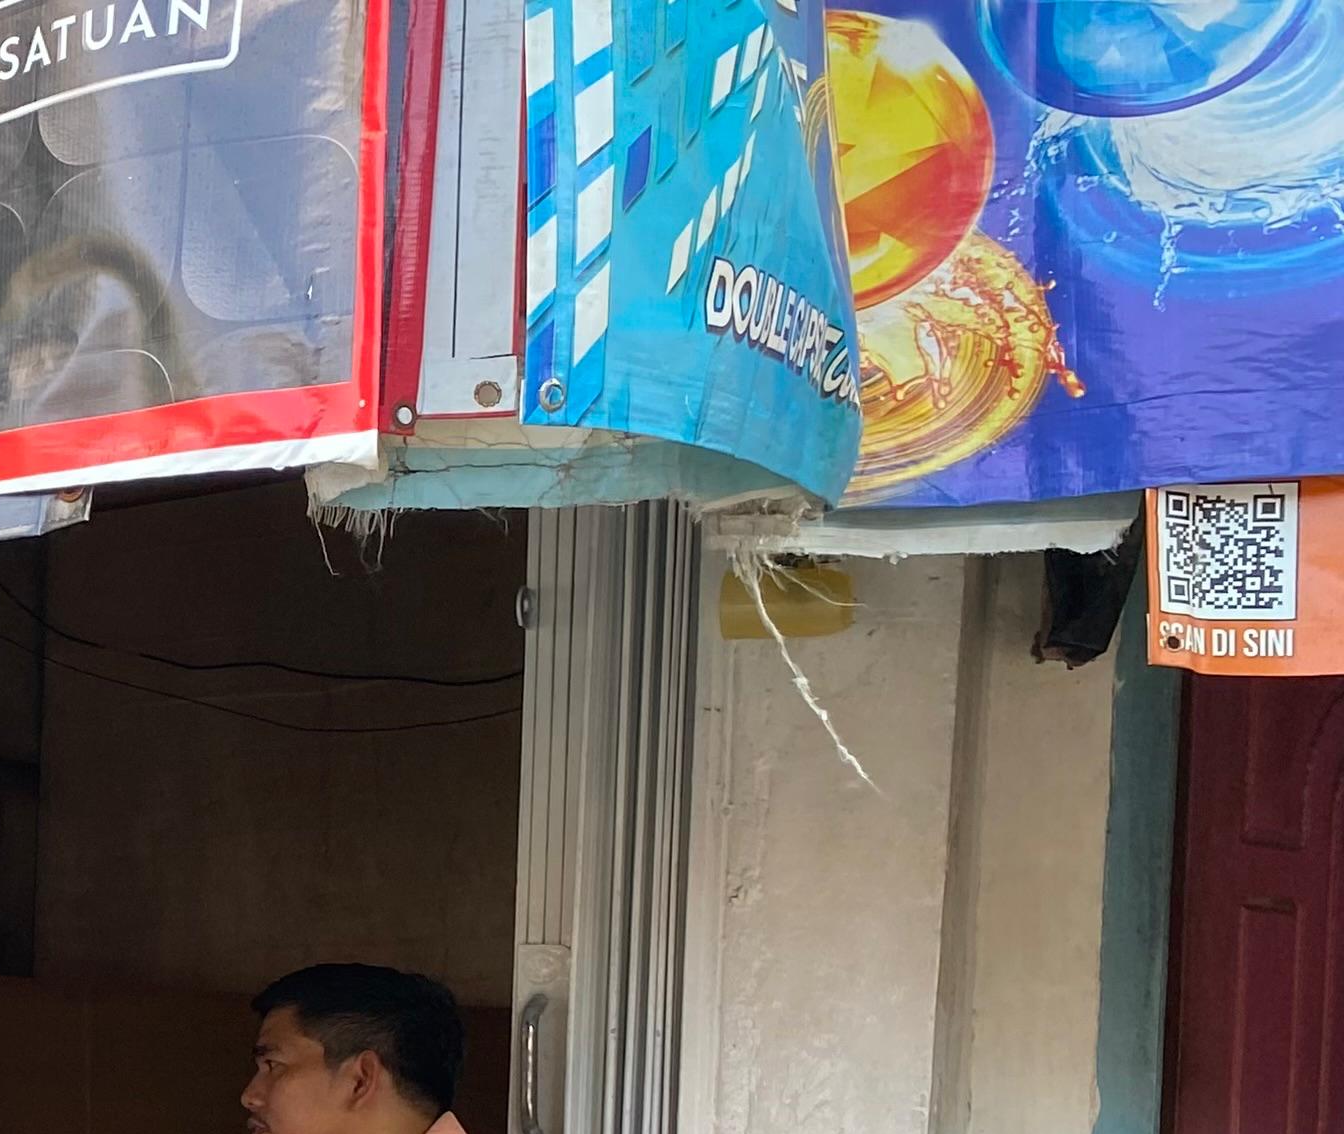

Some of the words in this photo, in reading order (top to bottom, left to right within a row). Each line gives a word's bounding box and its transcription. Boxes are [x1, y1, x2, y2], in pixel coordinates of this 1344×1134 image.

[706, 258, 796, 354] DOUBLE
[1212, 628, 1236, 657] DI
[1242, 628, 1294, 657] SINI
